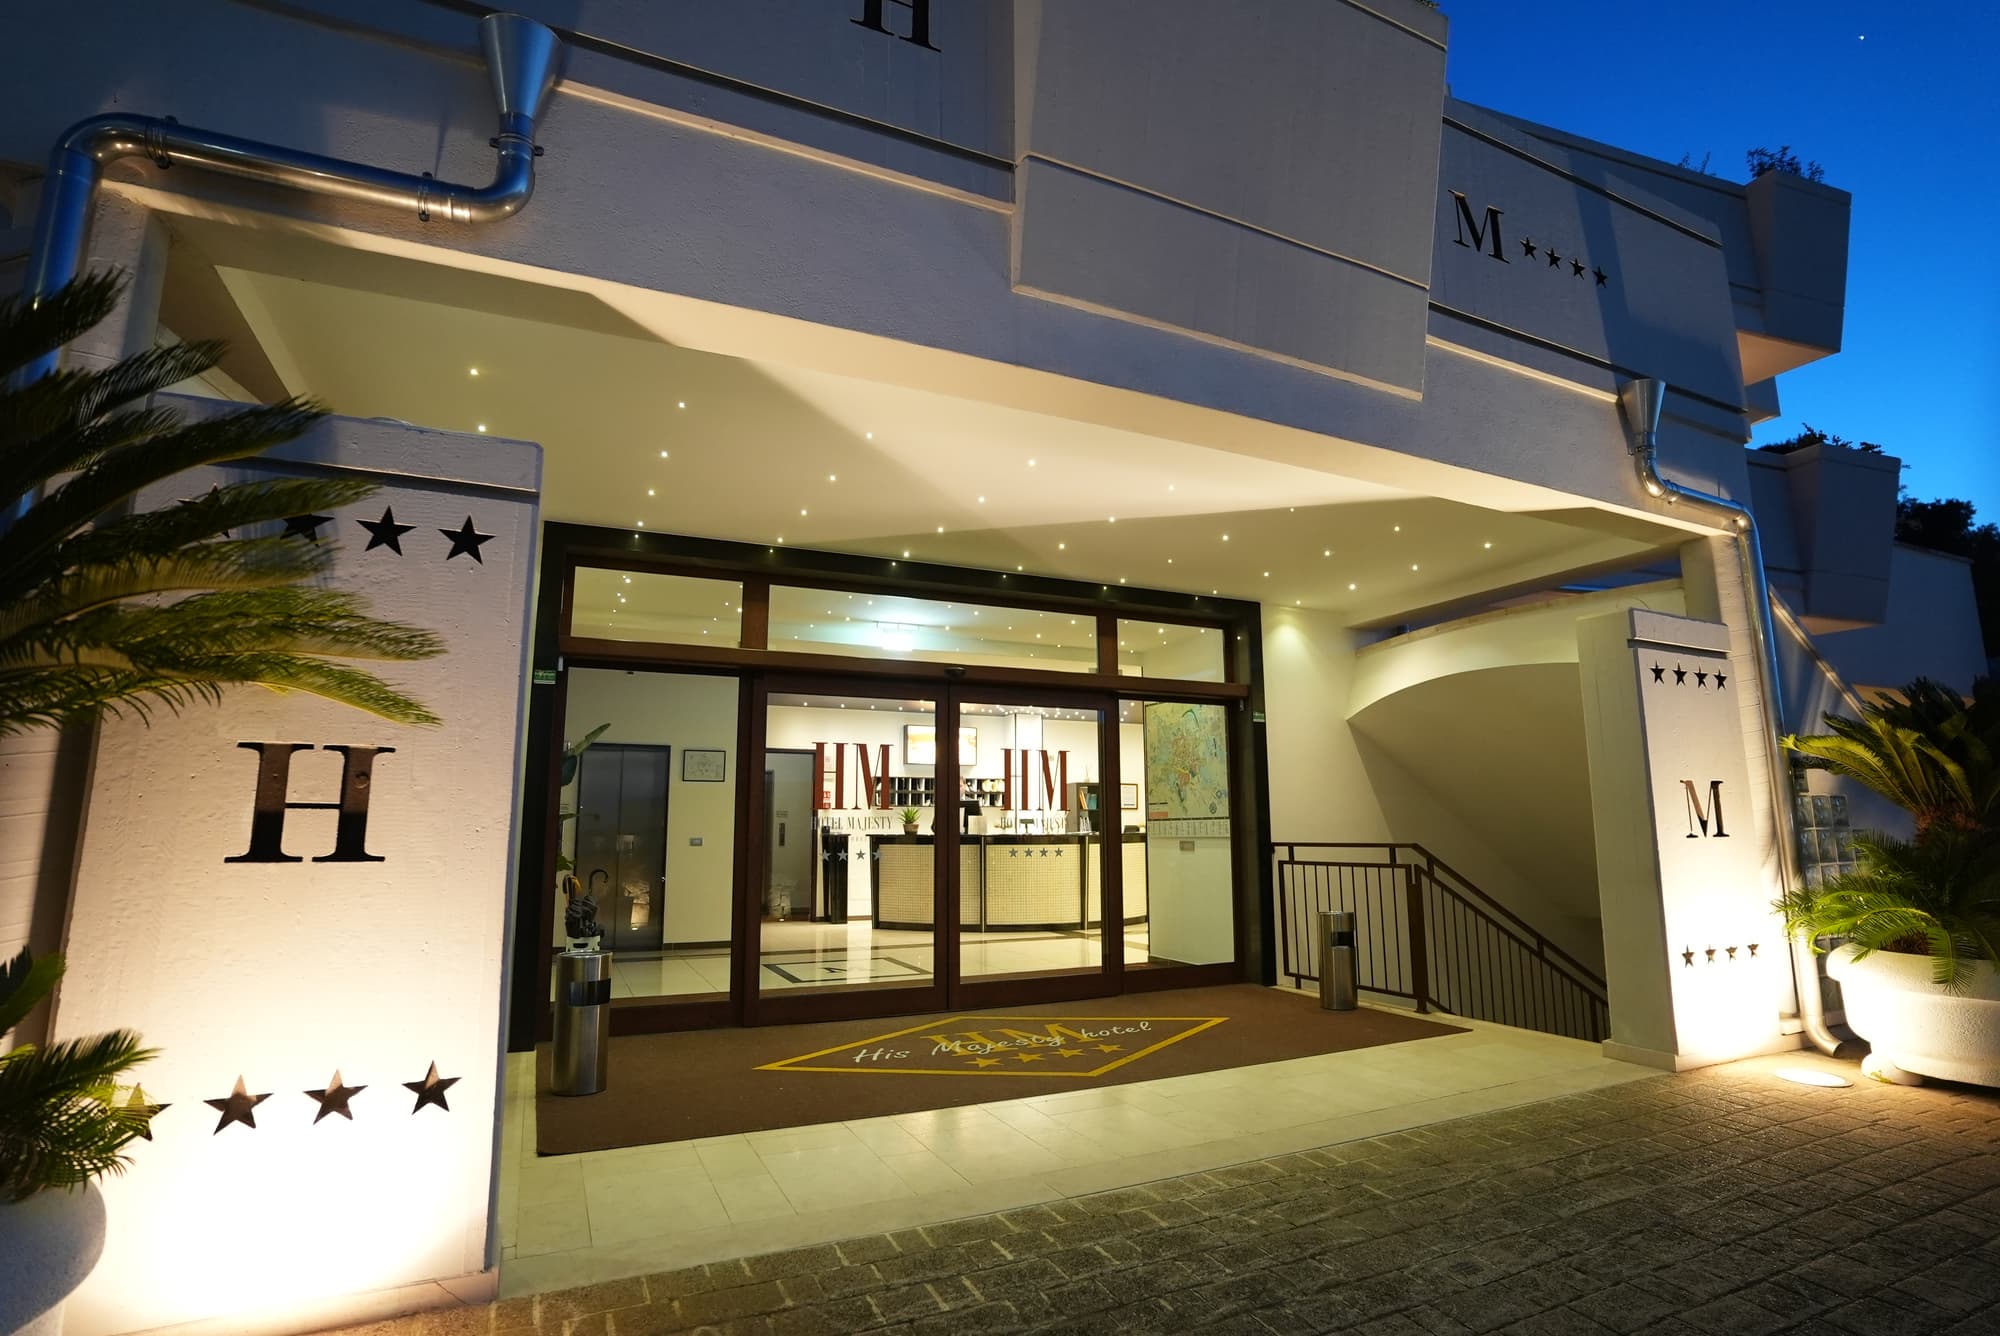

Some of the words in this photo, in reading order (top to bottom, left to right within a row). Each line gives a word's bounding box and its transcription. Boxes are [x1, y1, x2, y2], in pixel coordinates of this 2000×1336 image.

[1448, 188, 1510, 264] M
[224, 741, 396, 863] H
[811, 741, 894, 810] HM
[1000, 748, 1070, 811] HM
[847, 816, 892, 831] MAJESTY
[1680, 779, 1730, 838] M
[852, 1047, 911, 1063] His
[931, 1034, 1065, 1056] Majesty
[1081, 1021, 1152, 1039] hotel
